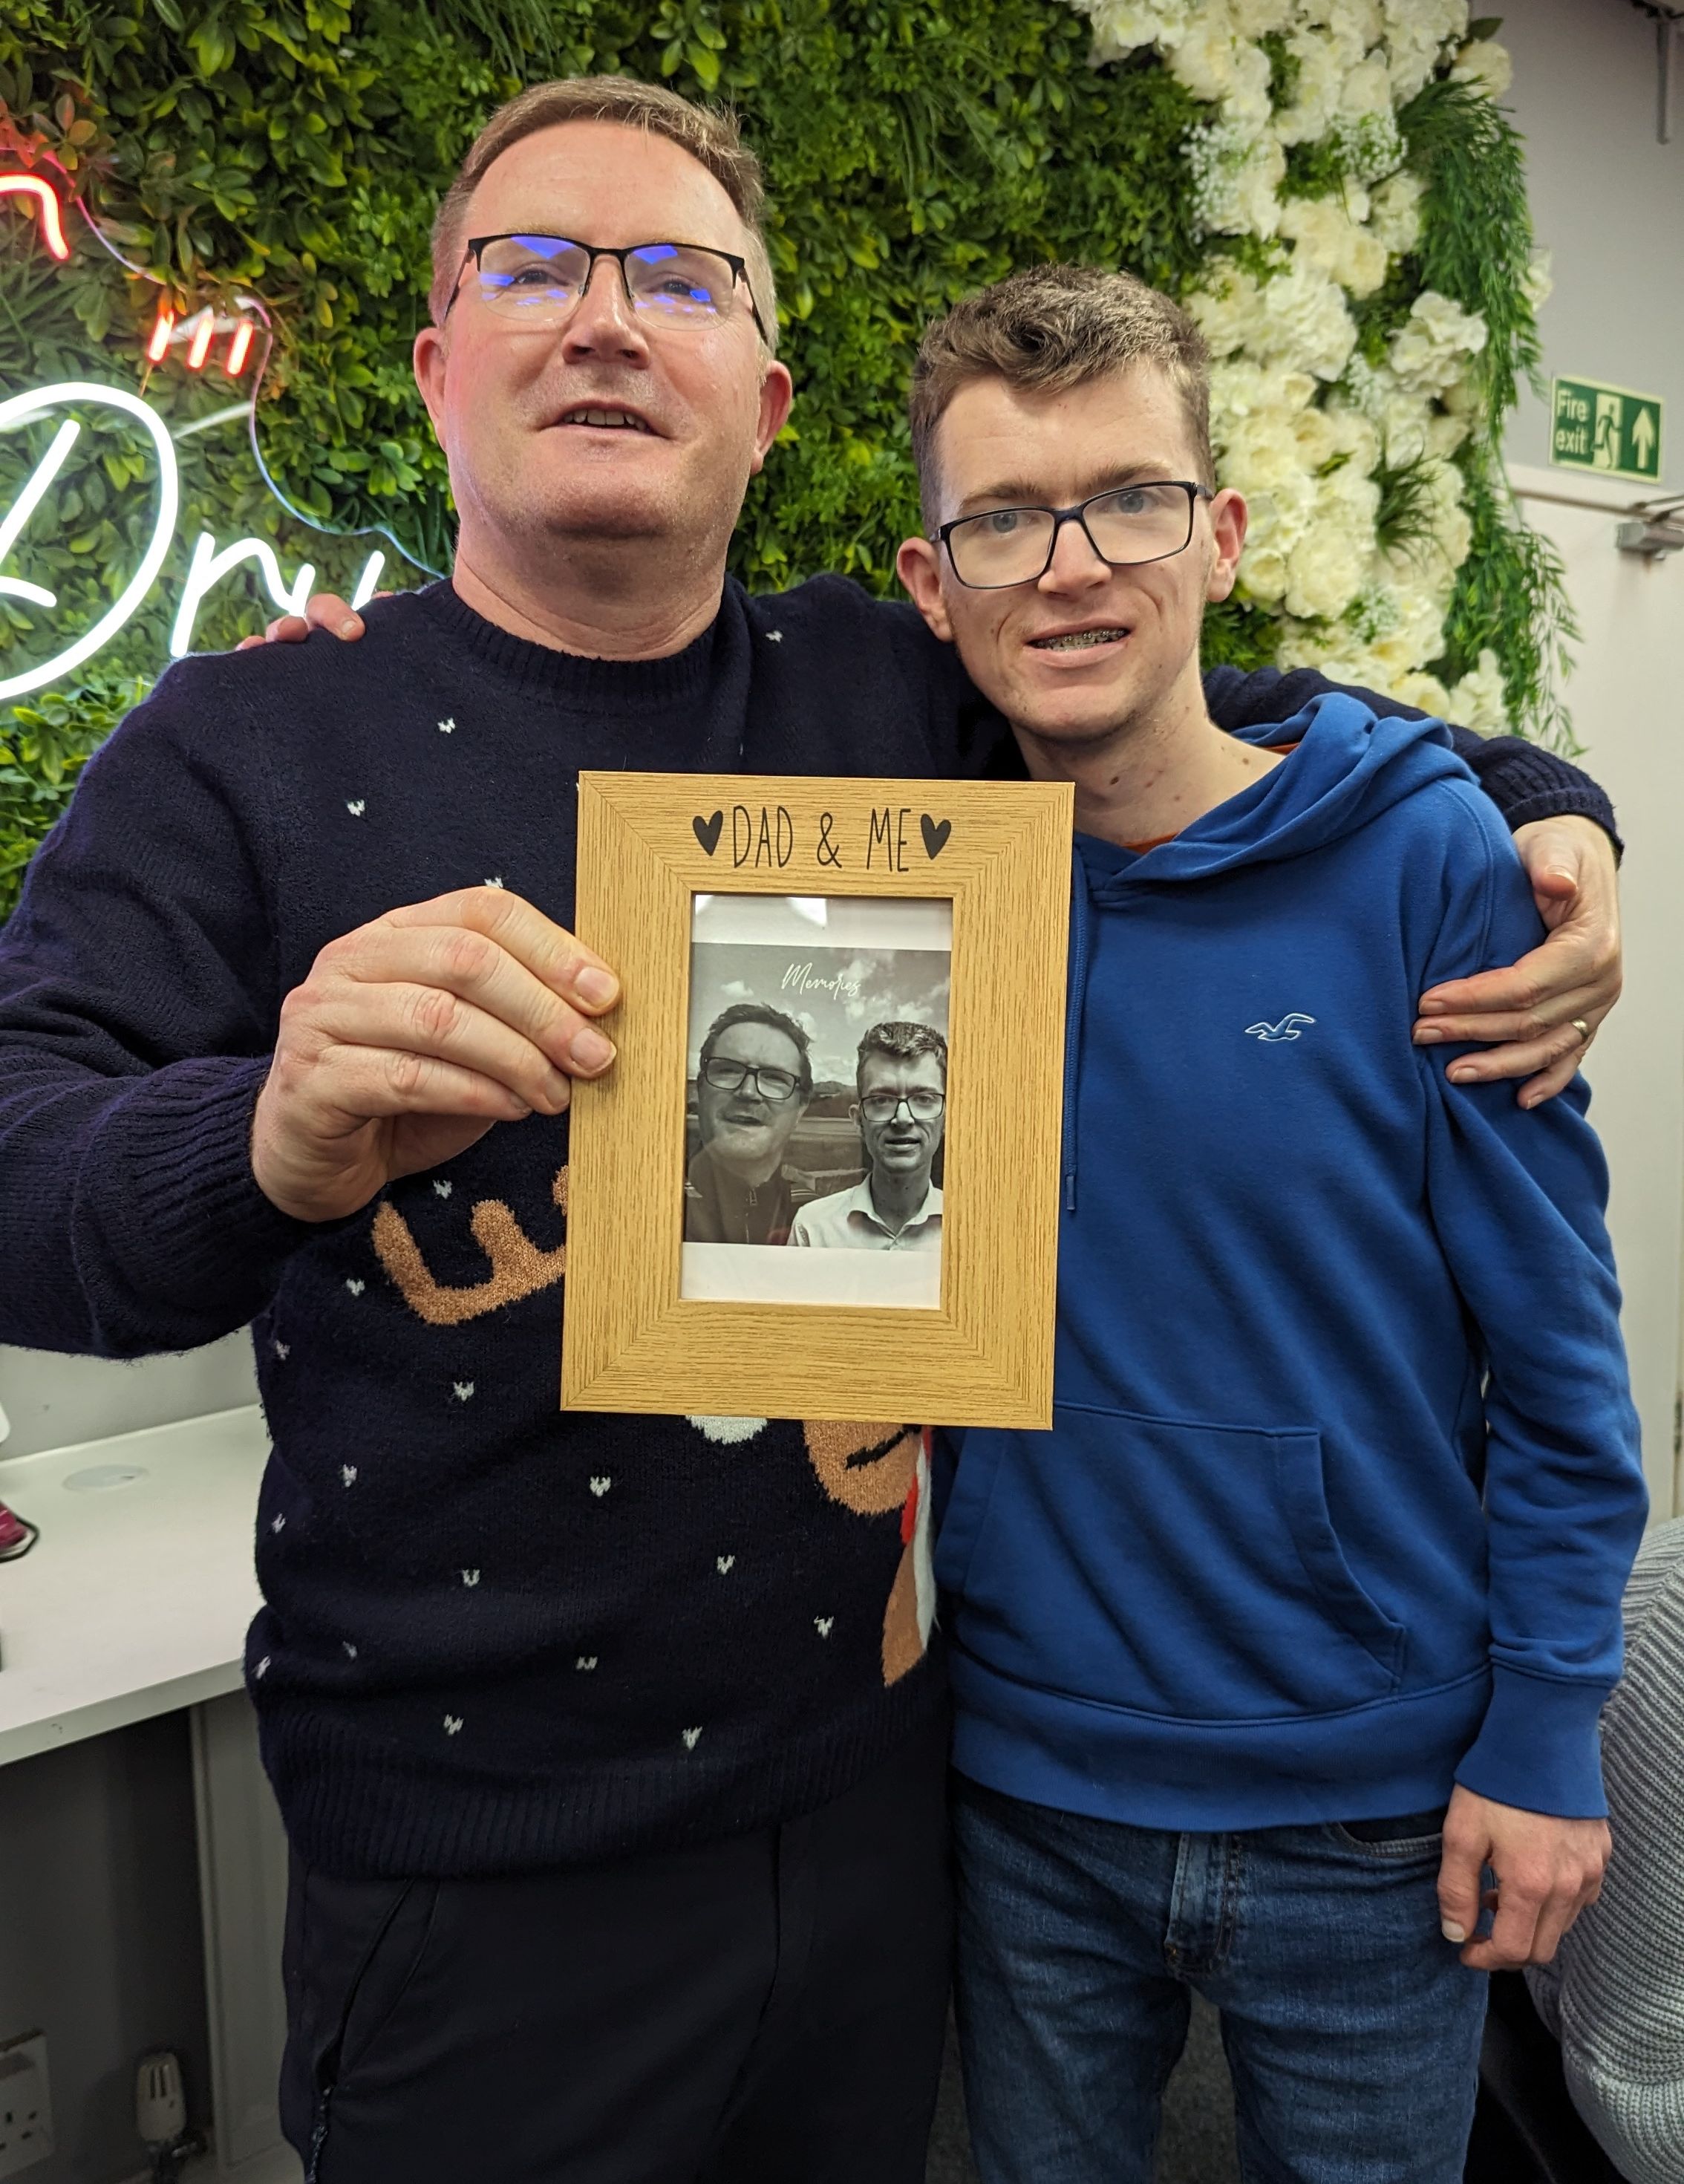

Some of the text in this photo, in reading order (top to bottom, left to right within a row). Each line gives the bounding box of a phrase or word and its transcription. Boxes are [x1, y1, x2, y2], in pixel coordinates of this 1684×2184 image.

[1557, 388, 1588, 423] Fire
[1556, 425, 1587, 455] exit
[733, 805, 911, 873] DAD & ME
[780, 962, 861, 1000] Memories
